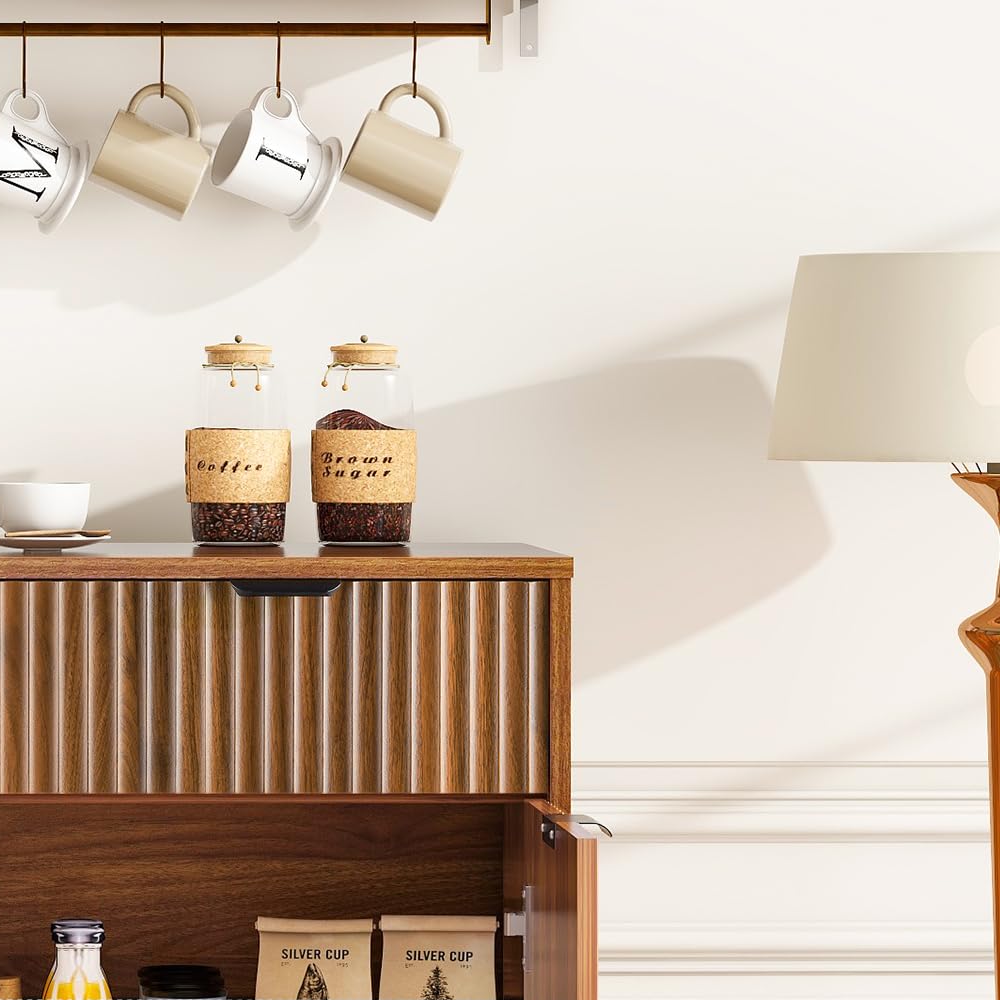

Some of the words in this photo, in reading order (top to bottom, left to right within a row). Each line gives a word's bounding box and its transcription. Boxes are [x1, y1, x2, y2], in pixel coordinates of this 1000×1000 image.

[321, 451, 394, 465] Brown
[197, 460, 264, 474] Coffee
[322, 466, 392, 480] Sugar
[281, 948, 321, 960] SILVER
[325, 949, 350, 960] CUP
[405, 950, 446, 961] SILVER
[449, 951, 474, 962] CUP
